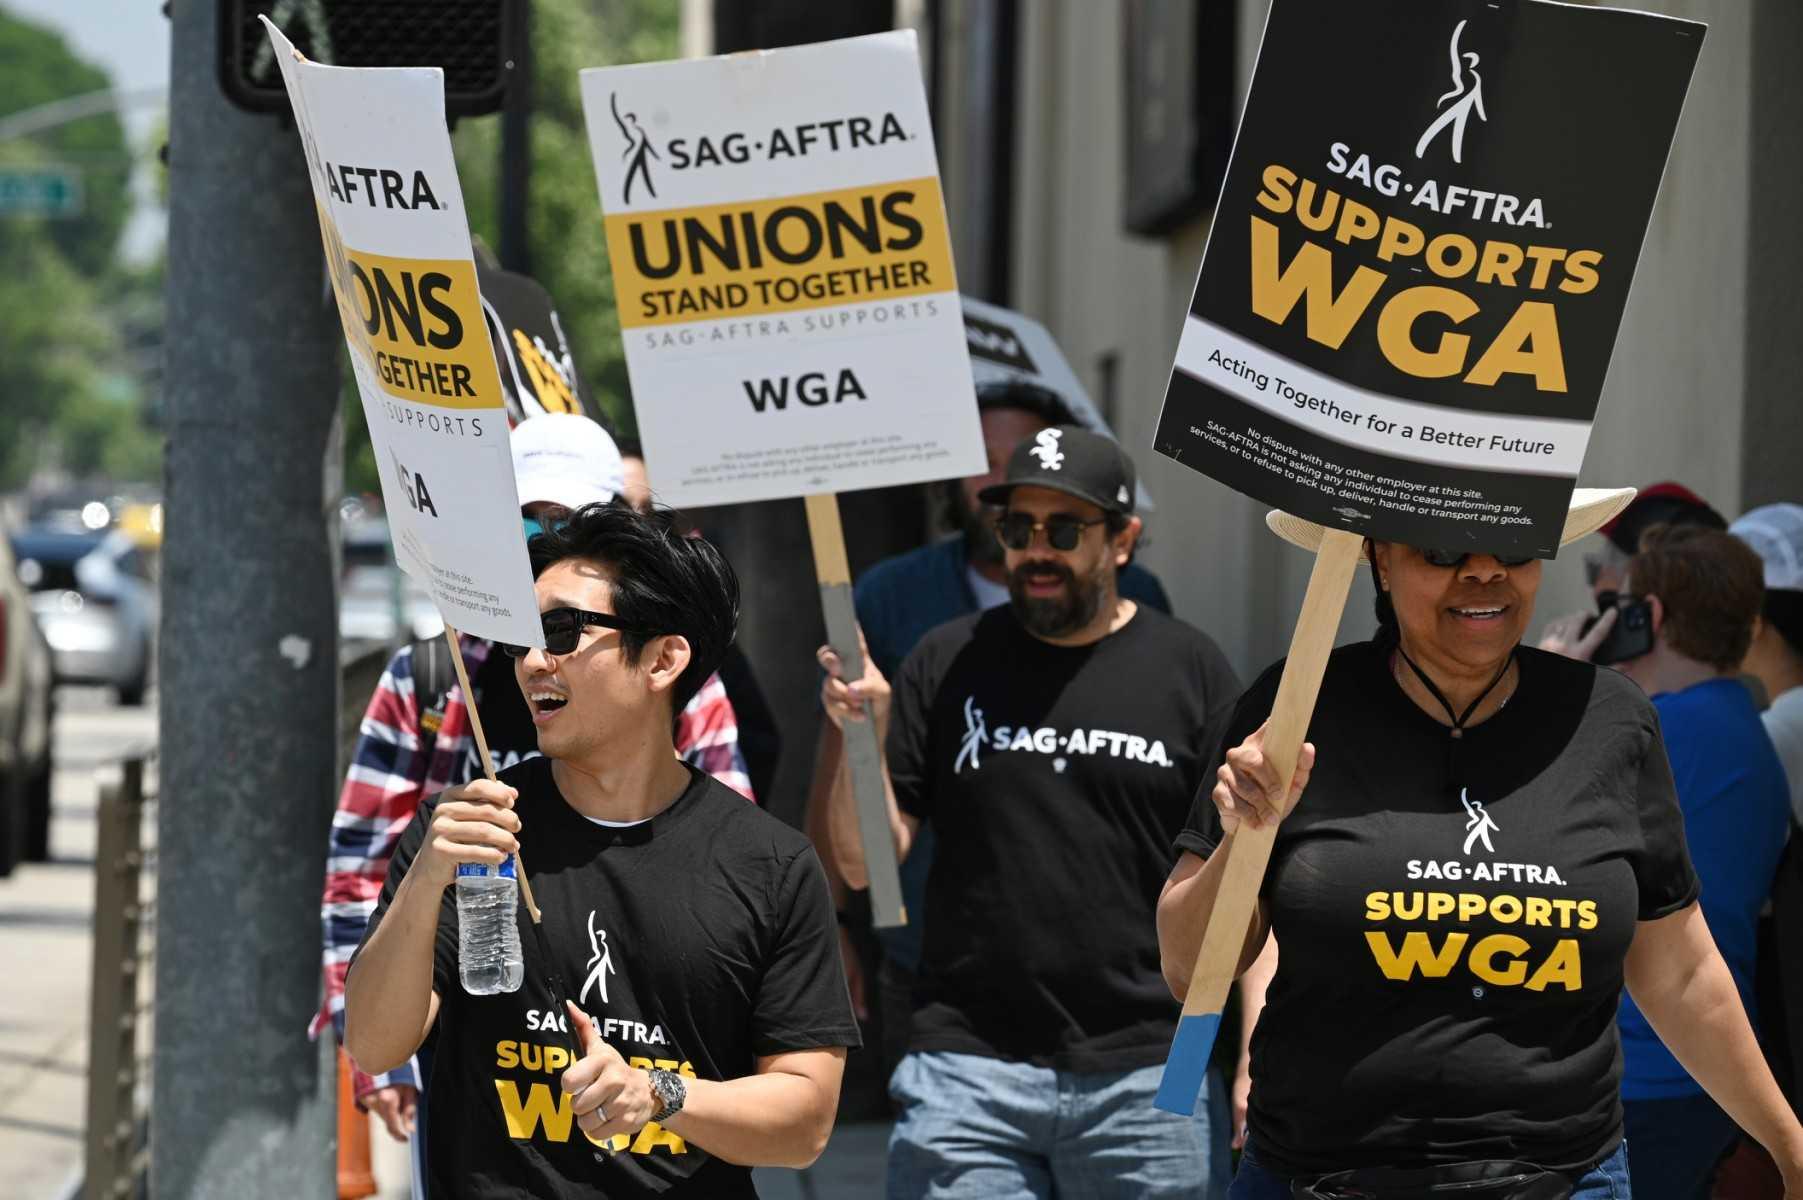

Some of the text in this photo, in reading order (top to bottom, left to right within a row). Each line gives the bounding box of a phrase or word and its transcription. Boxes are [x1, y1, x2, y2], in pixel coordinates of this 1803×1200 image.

[628, 191, 924, 280] UNIONS
[1255, 164, 1603, 295] SUPPORTS
[641, 260, 932, 319] STAND TOGETHER
[805, 300, 940, 332] SUPPORTS
[1250, 214, 1568, 393] WGA
[376, 351, 477, 398] GETHER
[743, 368, 867, 413] WGA
[1208, 348, 1556, 457] Acting Together for a Better Future
[390, 445, 438, 518] GA
[1189, 425, 1228, 451] services,
[1230, 445, 1241, 455] or
[1242, 449, 1252, 460] to
[1253, 456, 1283, 474] refuse
[1284, 468, 1295, 480] to
[1296, 474, 1319, 489] pick
[1320, 483, 1336, 497] up,
[1338, 489, 1377, 506] deliver,
[1378, 499, 1416, 513] handle
[1417, 506, 1430, 515] or
[1431, 508, 1479, 522] transport
[1480, 513, 1499, 525] any
[1500, 515, 1534, 526] goods.
[1247, 427, 1484, 499] No dispute with any other employer at this site.
[1261, 446, 1269, 456] is
[1270, 451, 1288, 464] not
[1289, 460, 1322, 479] asking
[1323, 473, 1343, 487] any
[1345, 478, 1397, 498] individual
[1399, 491, 1411, 500] to
[1412, 494, 1442, 506] cease
[1444, 499, 1501, 514] performing
[1503, 505, 1522, 515] any
[1365, 891, 1598, 930] SUPPORTS
[1364, 931, 1582, 992] WGA
[526, 1009, 668, 1045] SAAFTRA
[494, 1079, 688, 1155] WA
